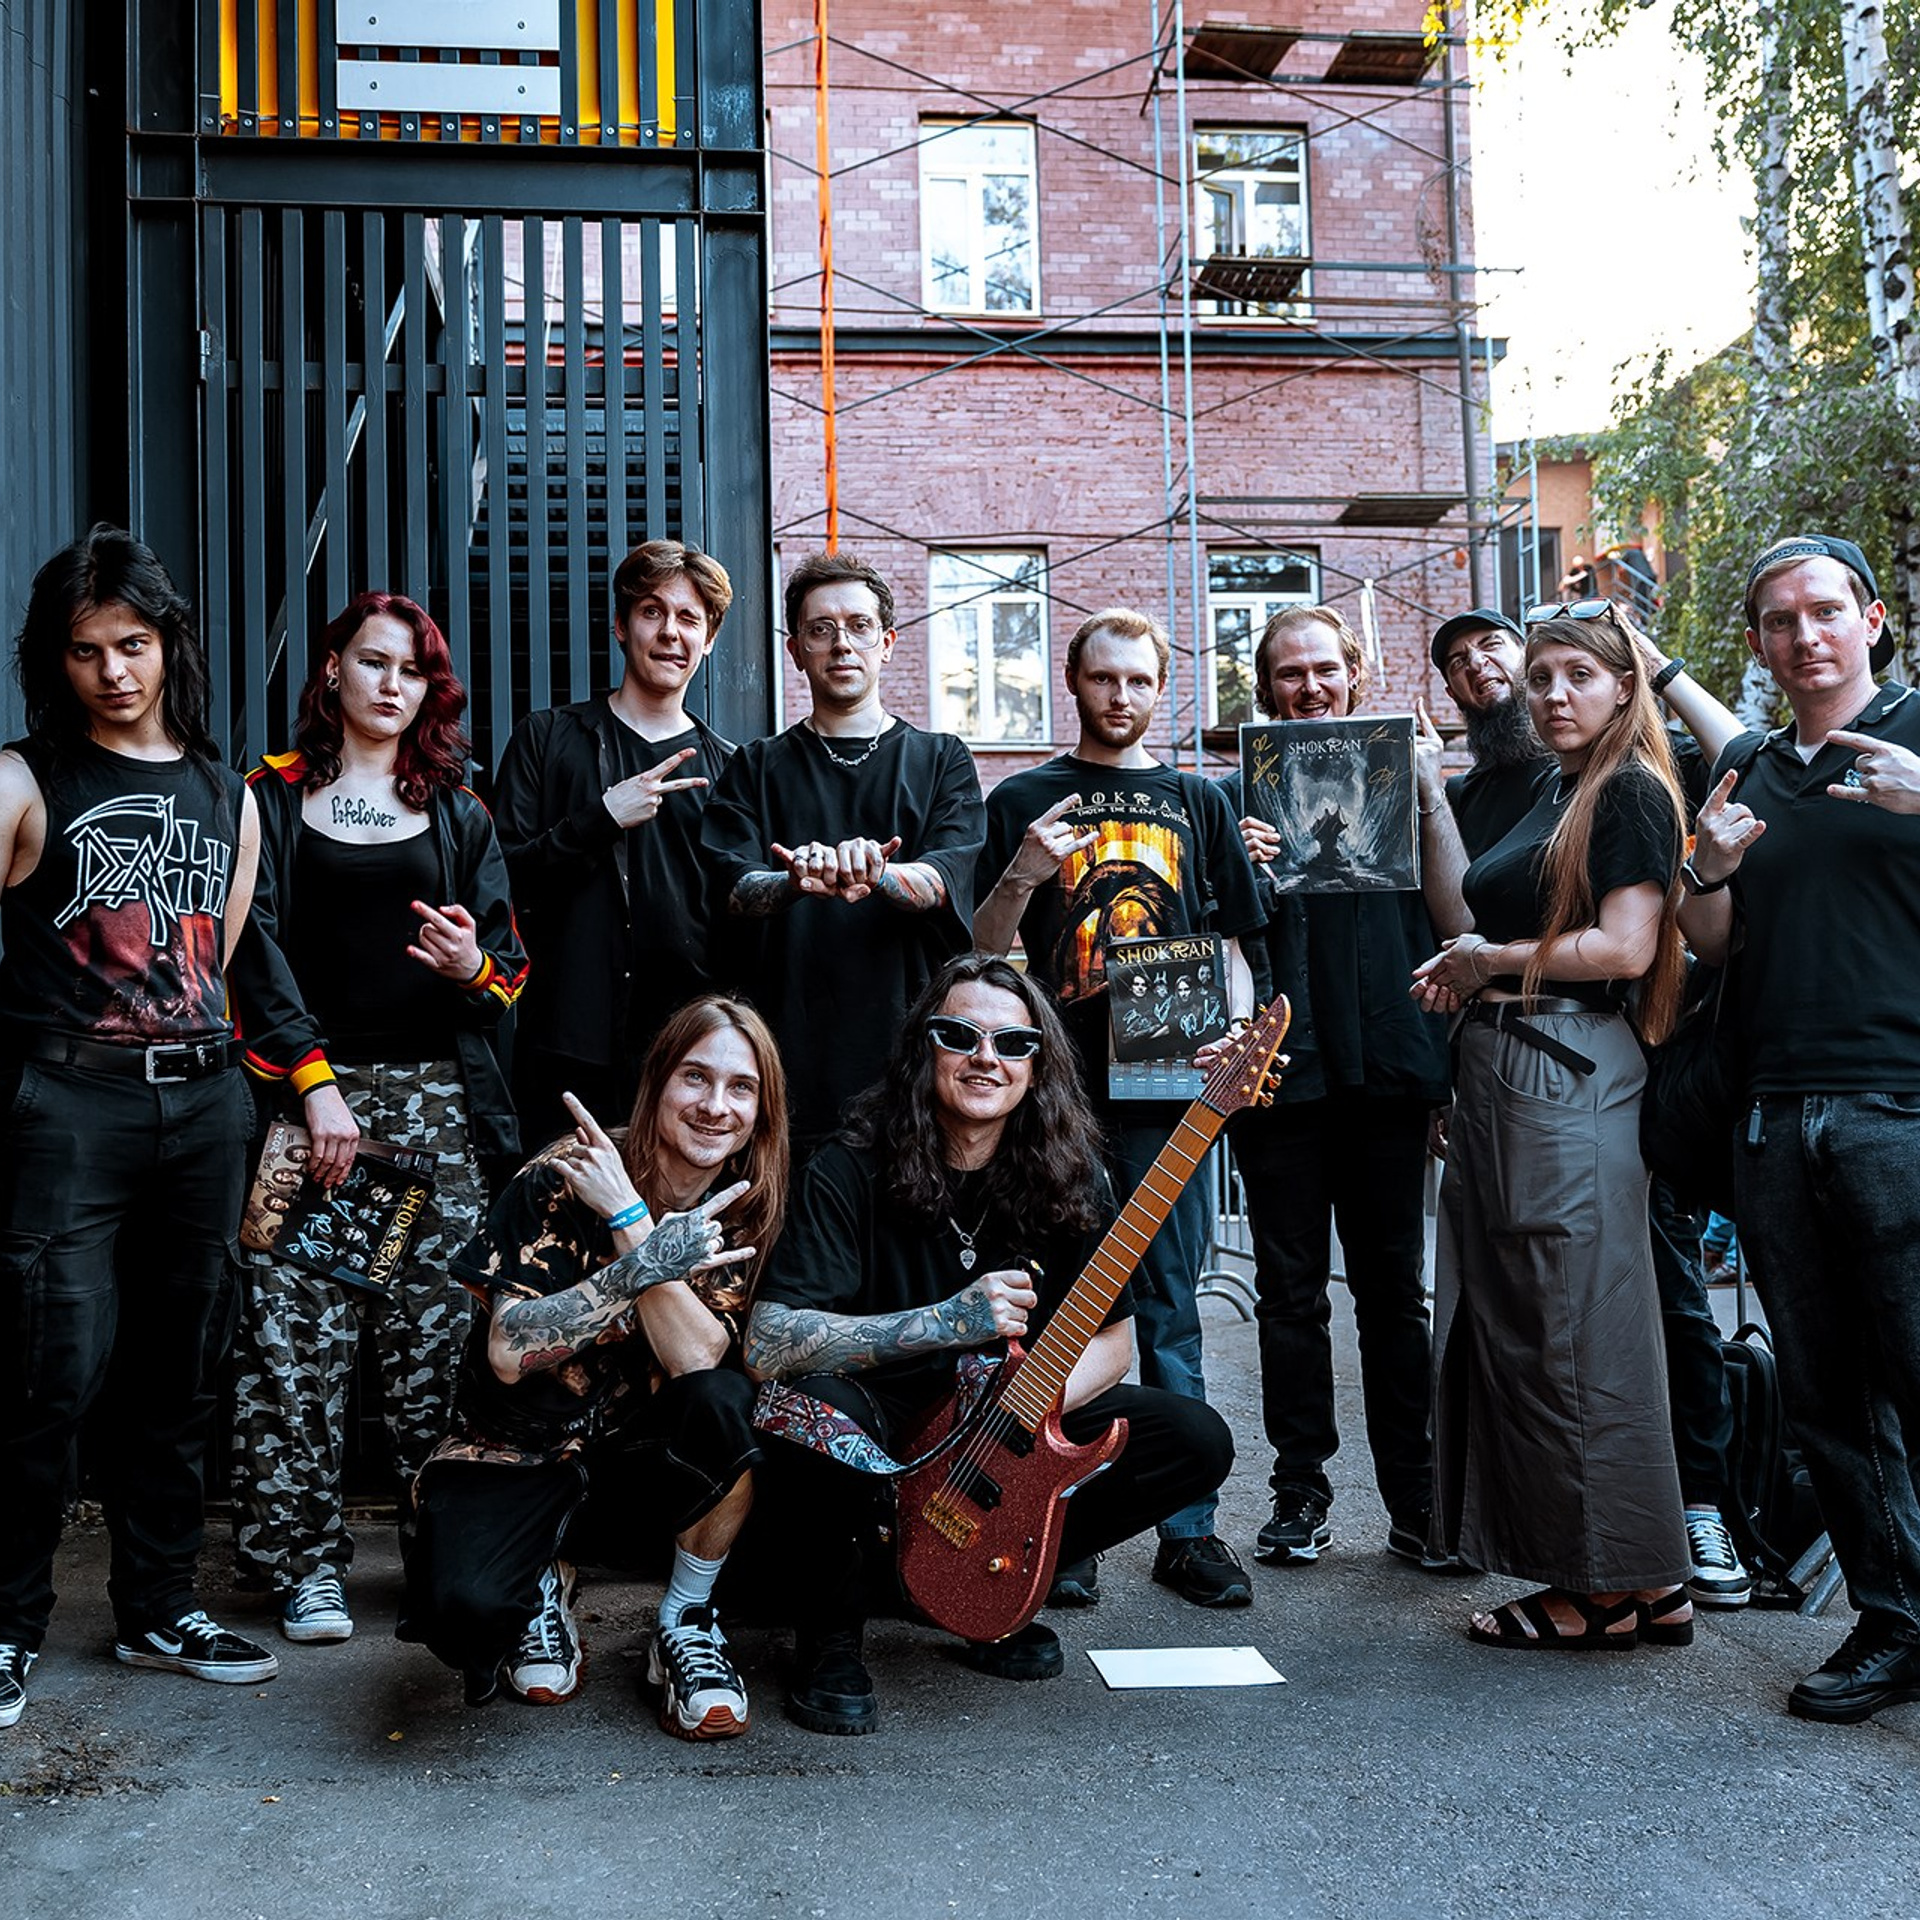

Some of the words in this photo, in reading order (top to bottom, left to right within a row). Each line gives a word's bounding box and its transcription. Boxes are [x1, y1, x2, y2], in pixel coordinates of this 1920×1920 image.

[1288, 737, 1362, 755] SHOKRAN
[54, 794, 231, 946] DEATH
[1116, 940, 1215, 965] SHOKRAN
[270, 1127, 285, 1154] 2024
[368, 1185, 427, 1285] SHOKRAN
